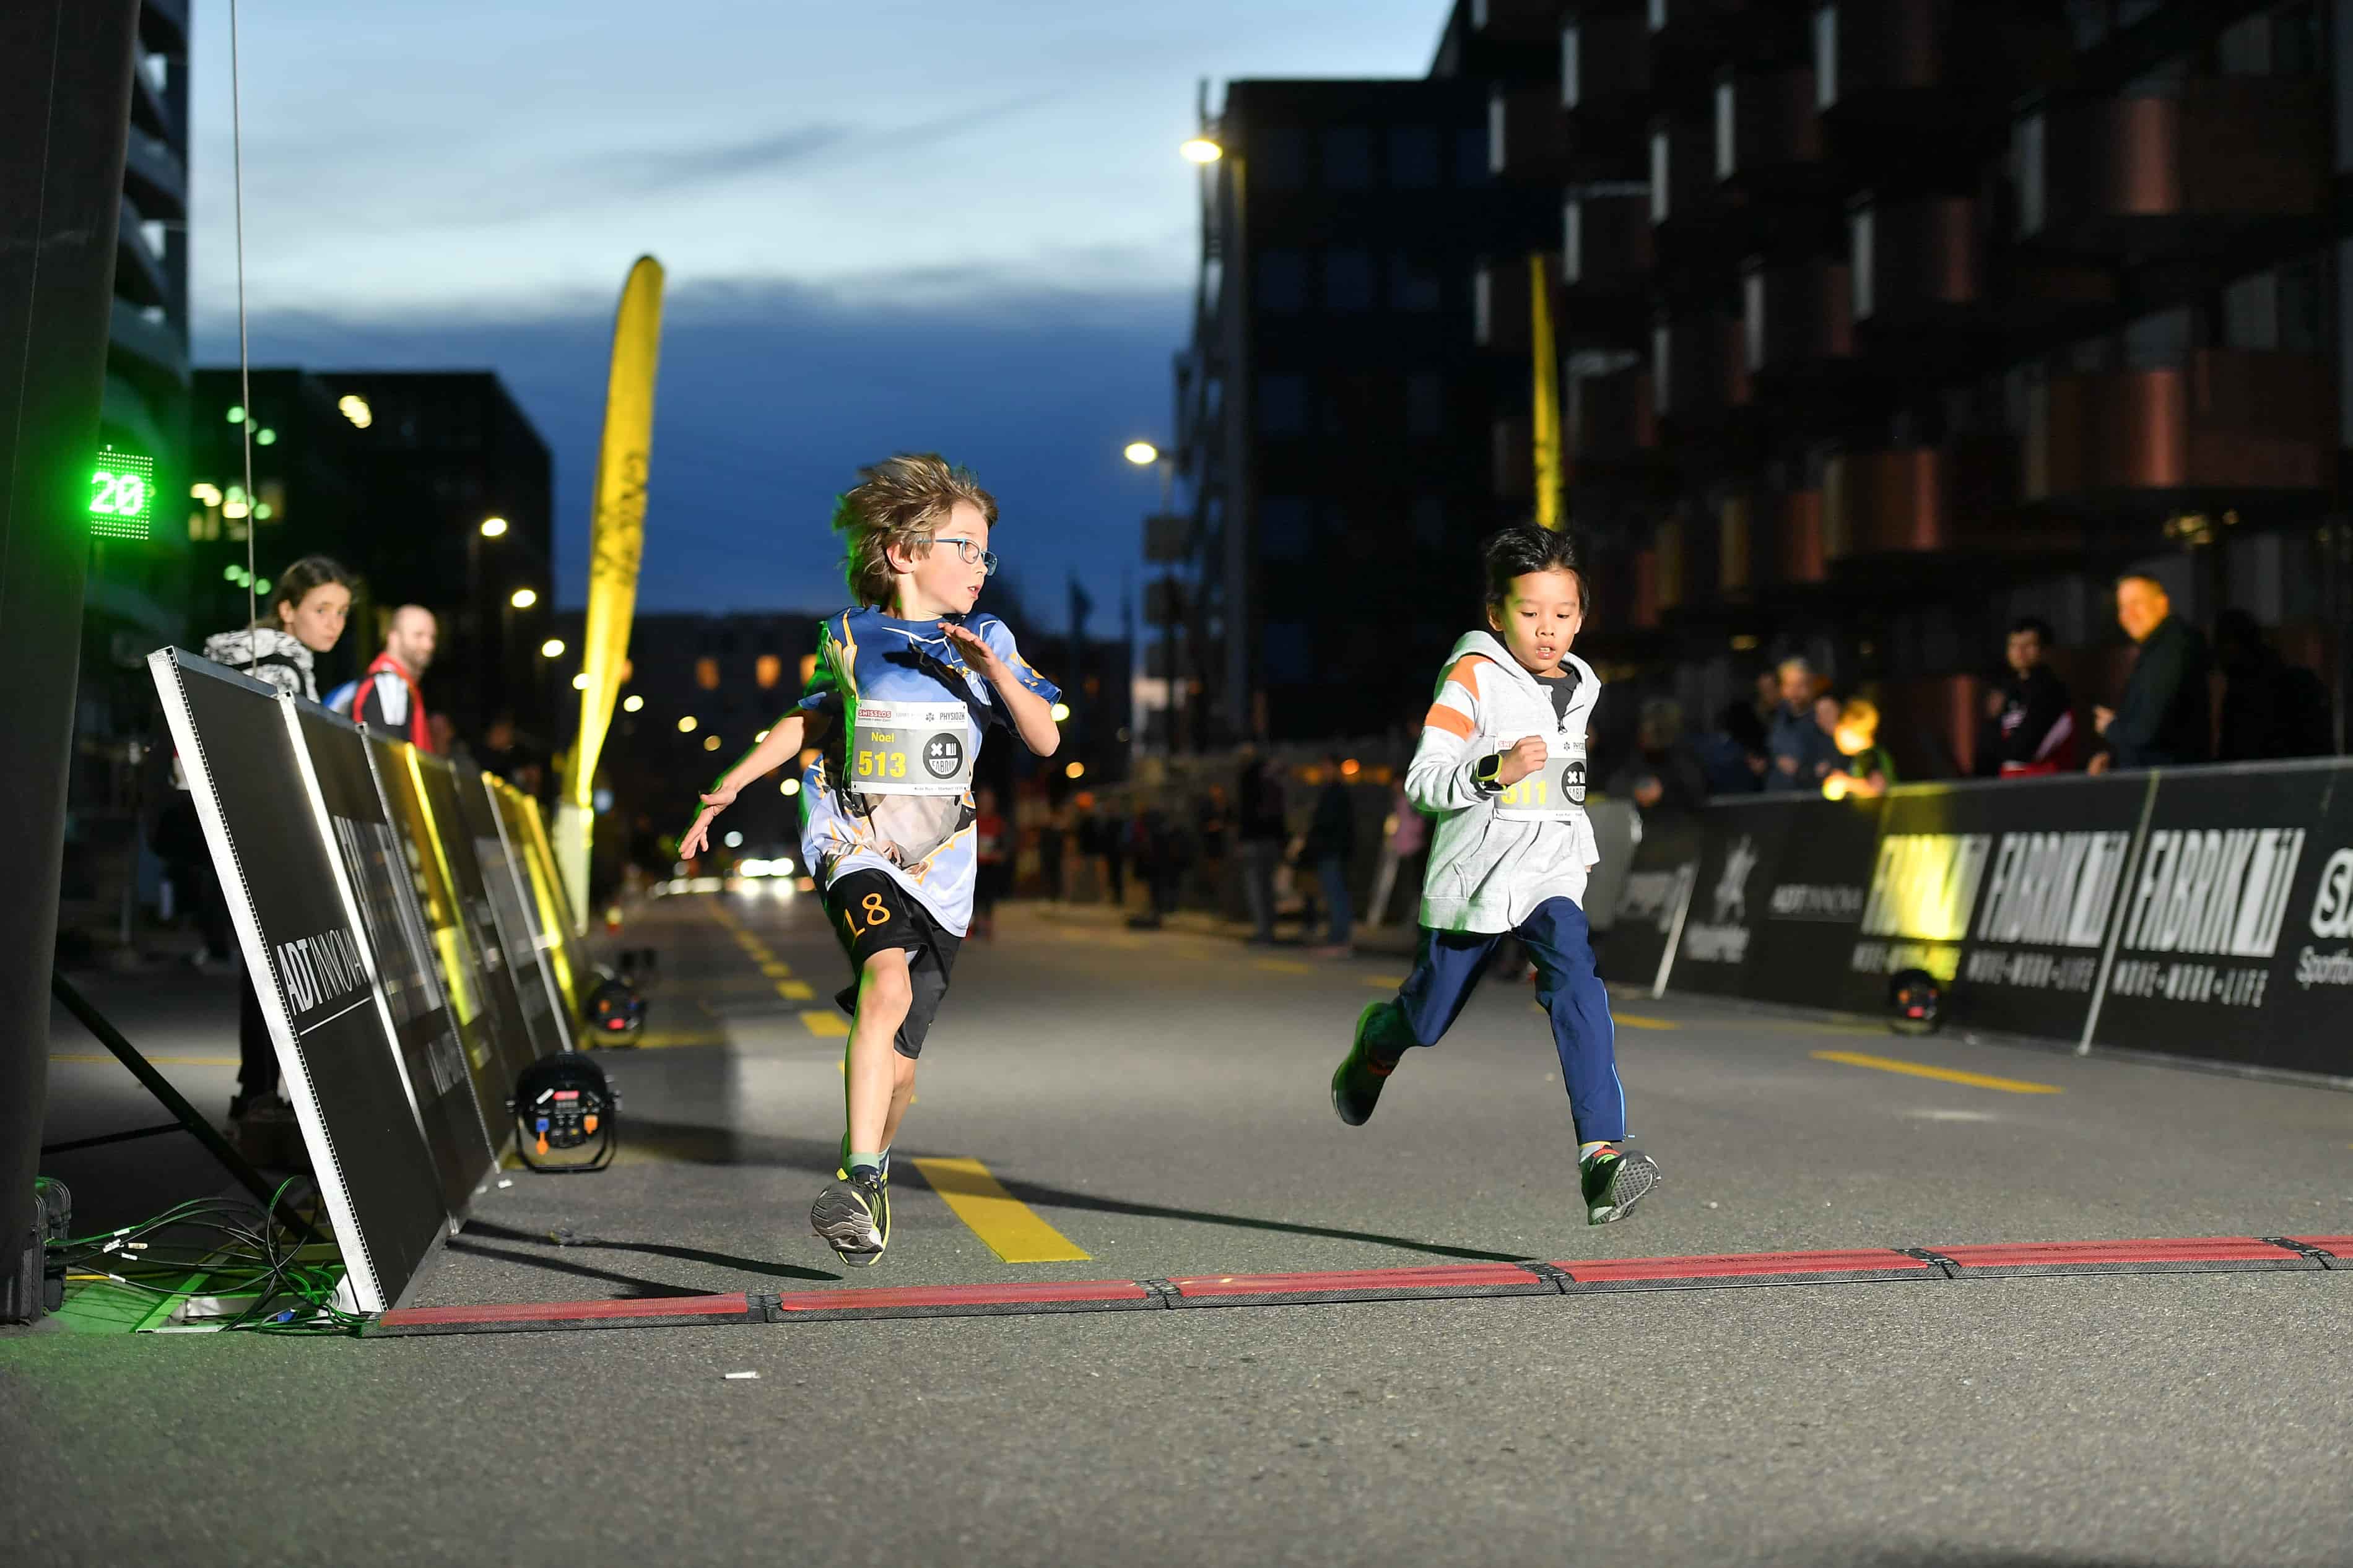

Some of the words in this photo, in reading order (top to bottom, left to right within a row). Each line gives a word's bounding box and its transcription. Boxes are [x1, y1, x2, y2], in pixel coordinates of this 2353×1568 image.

[89, 471, 146, 516] 20
[858, 709, 891, 718] SWISSLOS
[871, 732, 895, 743] Noel
[858, 750, 907, 778] 513
[2124, 828, 2258, 955] FABRIK
